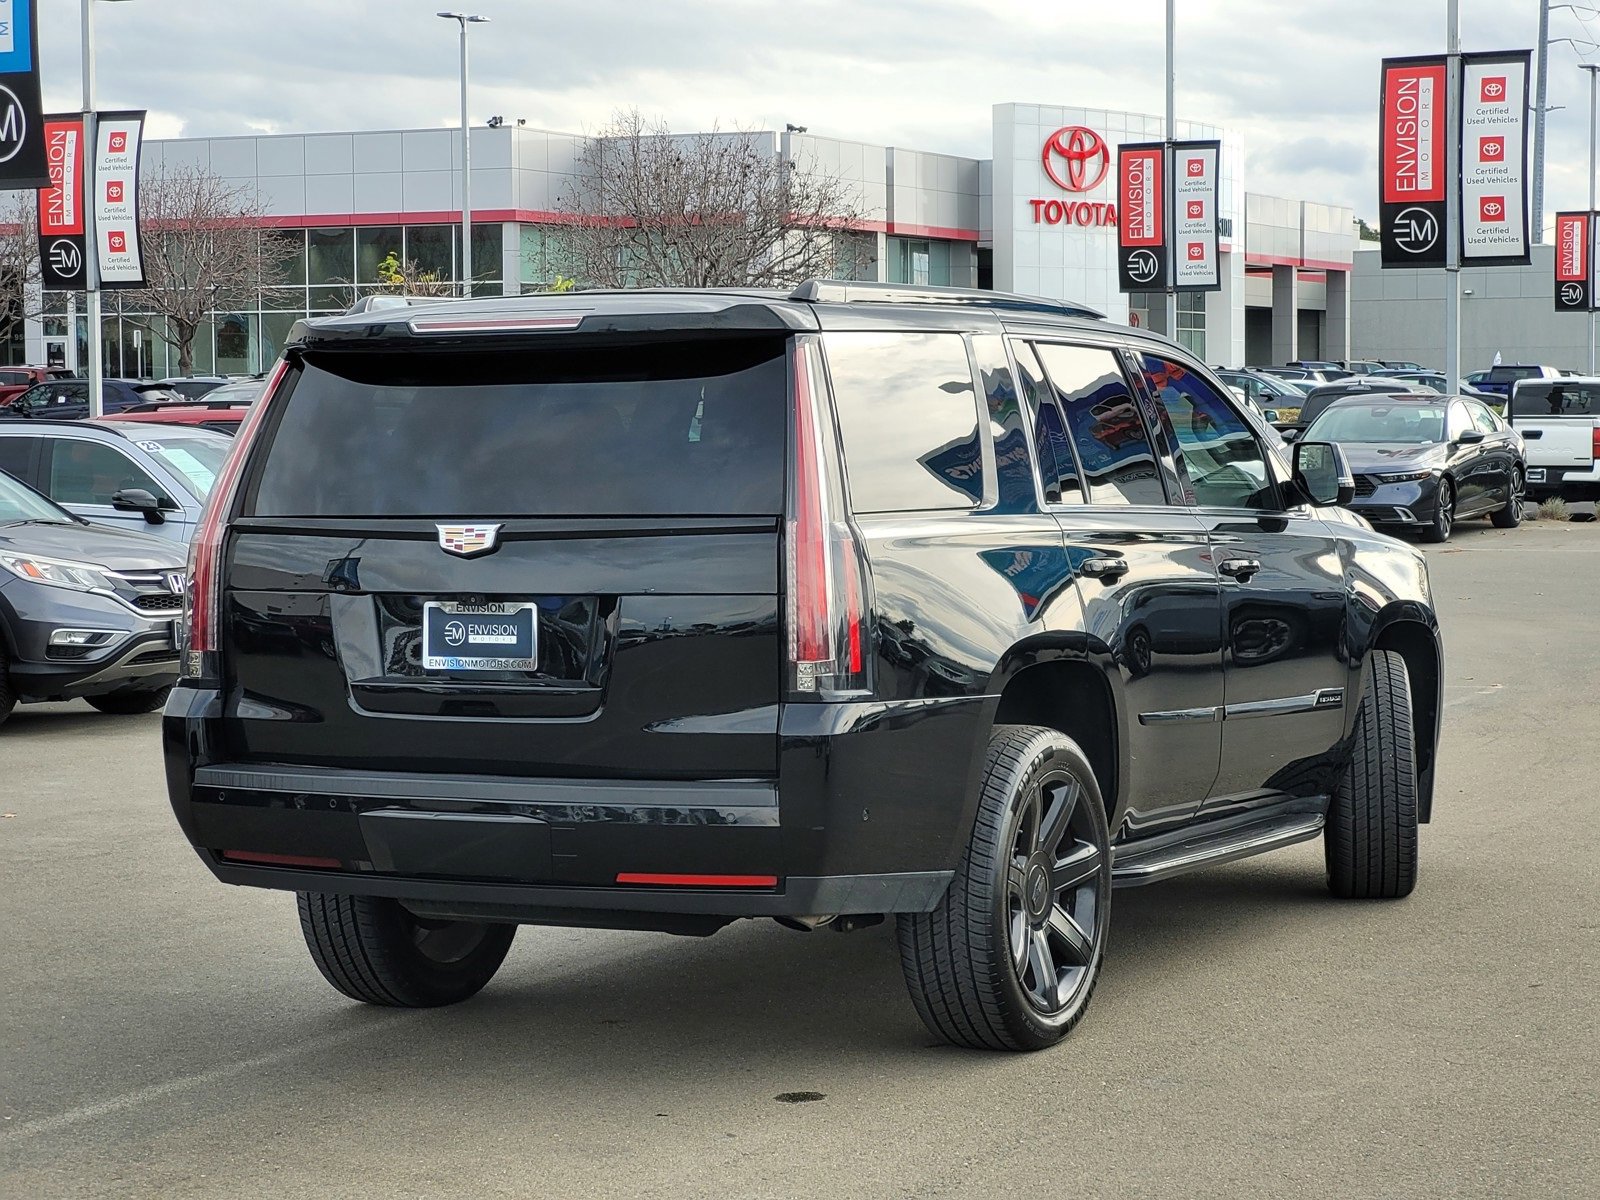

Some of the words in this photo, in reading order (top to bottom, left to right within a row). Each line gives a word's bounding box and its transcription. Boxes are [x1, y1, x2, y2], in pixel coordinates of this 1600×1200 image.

[1476, 107, 1509, 116] Certified
[1466, 117, 1485, 125] Used
[1487, 116, 1518, 124] Vehicles
[1396, 78, 1417, 191] ENVISION
[1421, 88, 1431, 180] MOTORS
[1475, 167, 1508, 175] Certified
[49, 131, 66, 226] ENVISION
[65, 138, 75, 217] MOTORS
[1466, 176, 1485, 184] Used
[1487, 175, 1518, 184] Vehicles
[1129, 158, 1144, 239] ENVISION
[1030, 200, 1117, 226] TOYOTA
[1476, 227, 1509, 235] Certified
[1467, 236, 1486, 244] Used
[1488, 235, 1519, 244] Vehicles
[1562, 221, 1573, 276] ENVISION
[456, 604, 505, 613] ENVISION
[468, 624, 517, 635] ENVISION
[429, 659, 532, 669] ENVISIONMOTORS.COM
